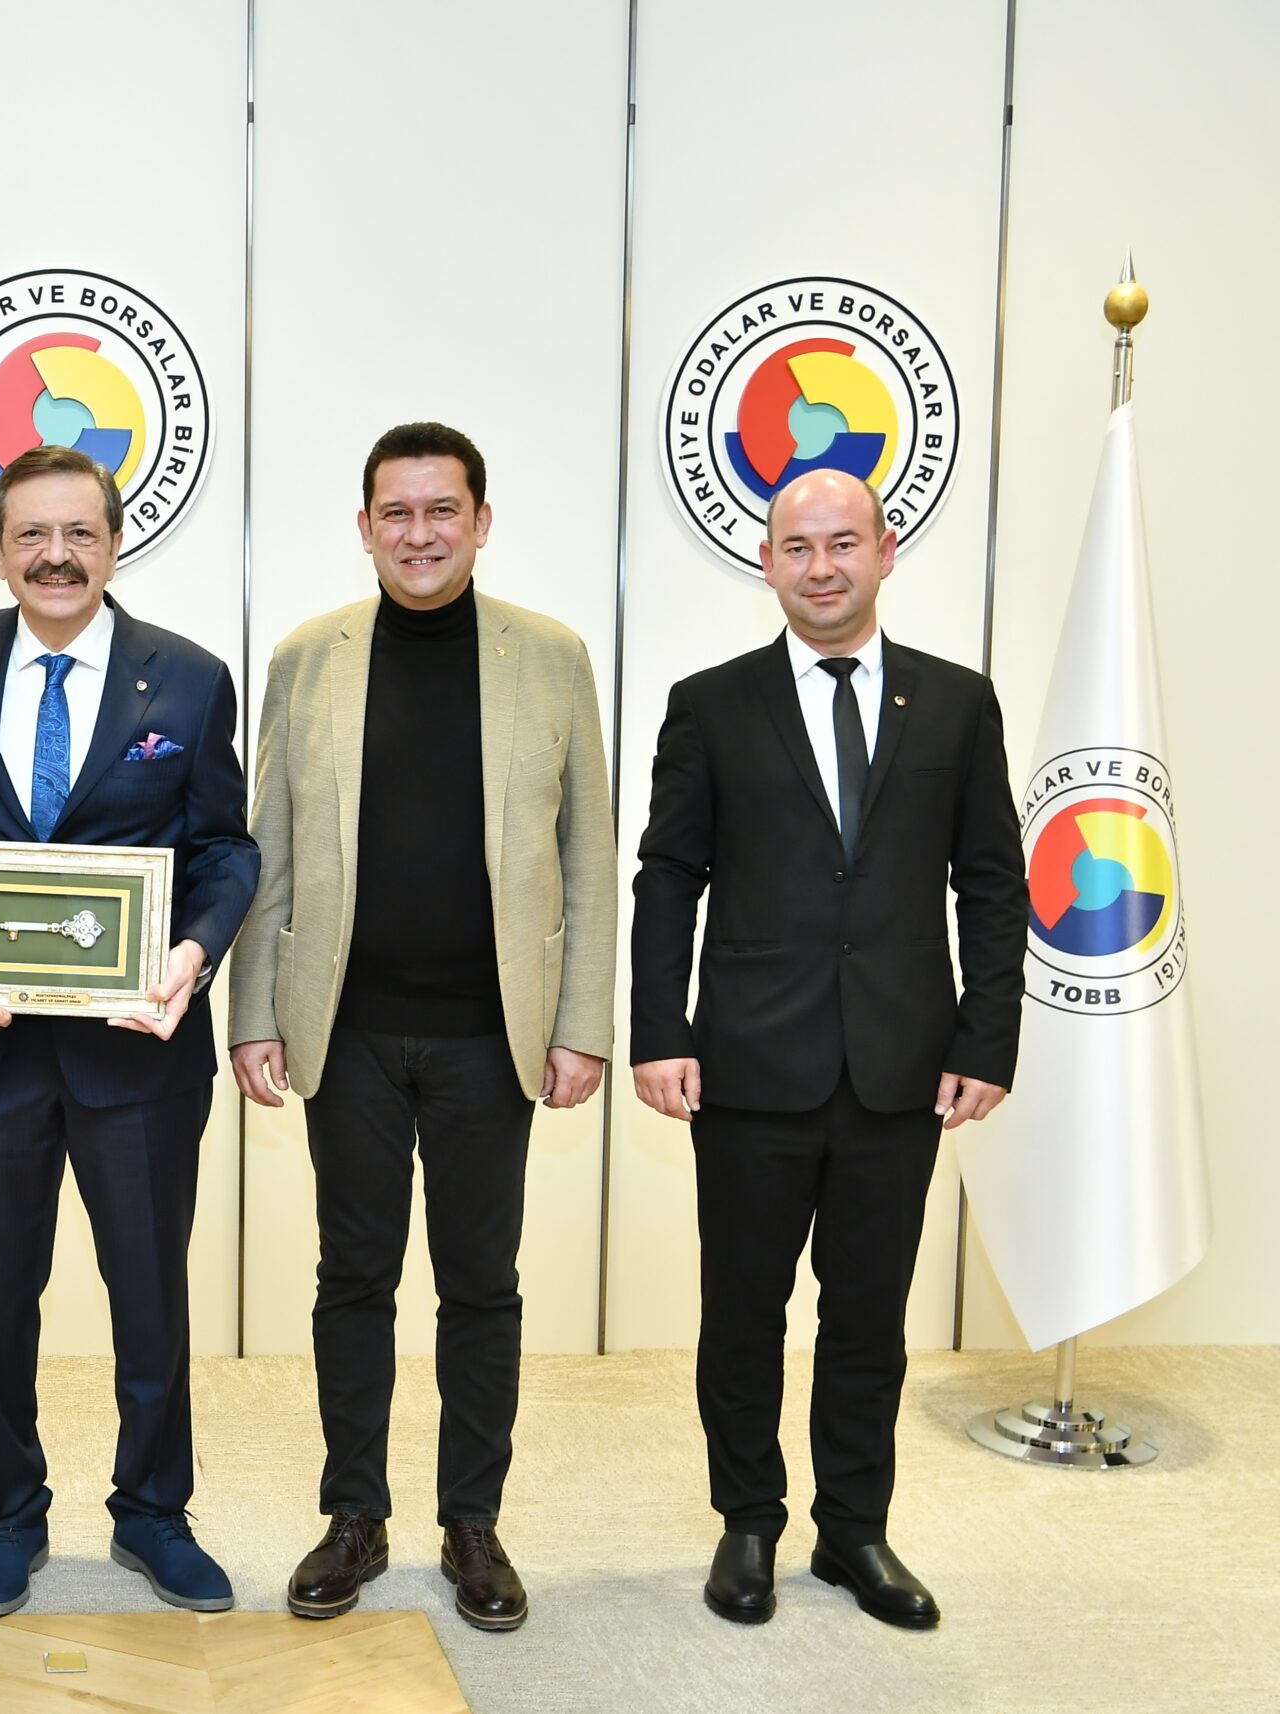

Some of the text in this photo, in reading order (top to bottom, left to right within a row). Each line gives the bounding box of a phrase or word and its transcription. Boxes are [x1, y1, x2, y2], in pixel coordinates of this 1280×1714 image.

[28, 285, 65, 305] VE
[80, 288, 191, 411] BORSALAR
[679, 293, 943, 536] TÜRKİYE ODALAR VE BORSALAR BİRLİĞ
[130, 425, 194, 532] BİRLİĞİ
[1020, 766, 1074, 829] DALAR
[1086, 761, 1123, 777] VE
[1049, 980, 1122, 1005] TOBB
